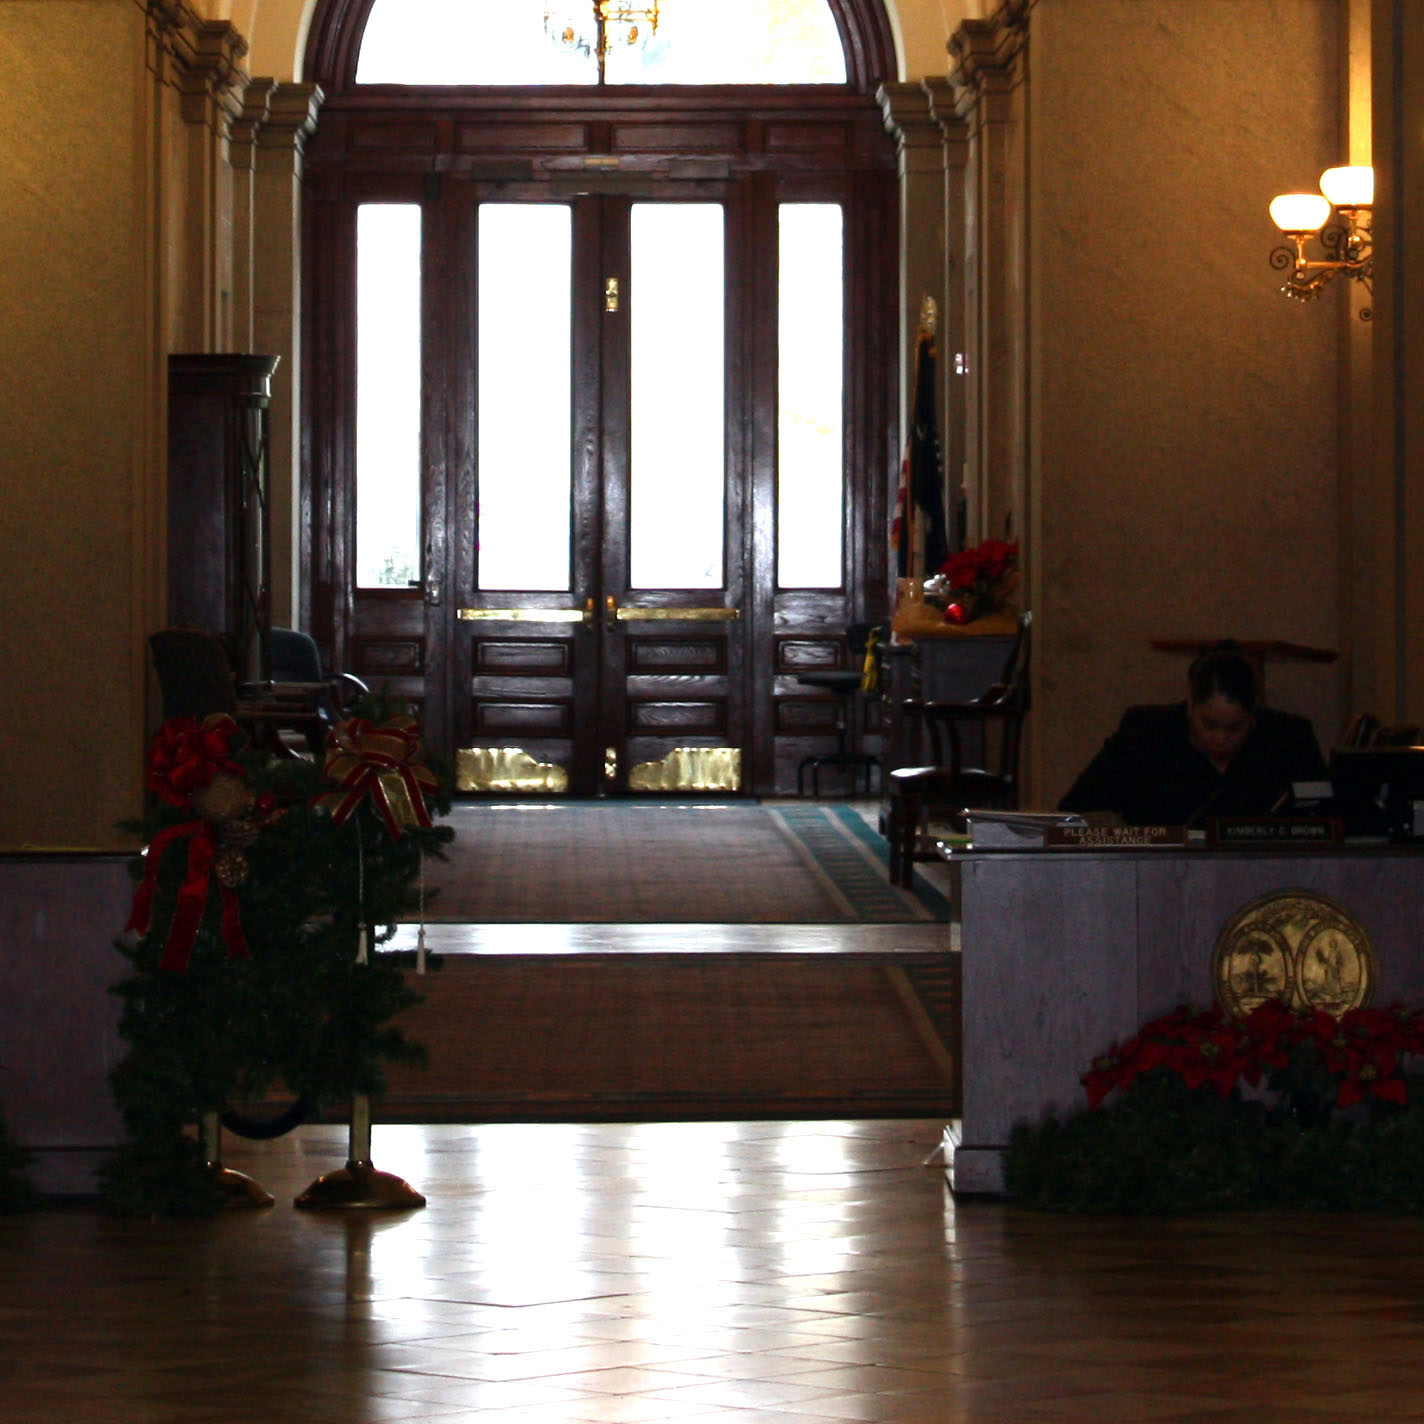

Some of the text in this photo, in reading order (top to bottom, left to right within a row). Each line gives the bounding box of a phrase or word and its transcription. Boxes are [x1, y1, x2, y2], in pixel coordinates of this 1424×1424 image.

[1064, 827, 1167, 837] PLEASE WAIT FOR
[1079, 836, 1151, 845] ASSISTANCE
